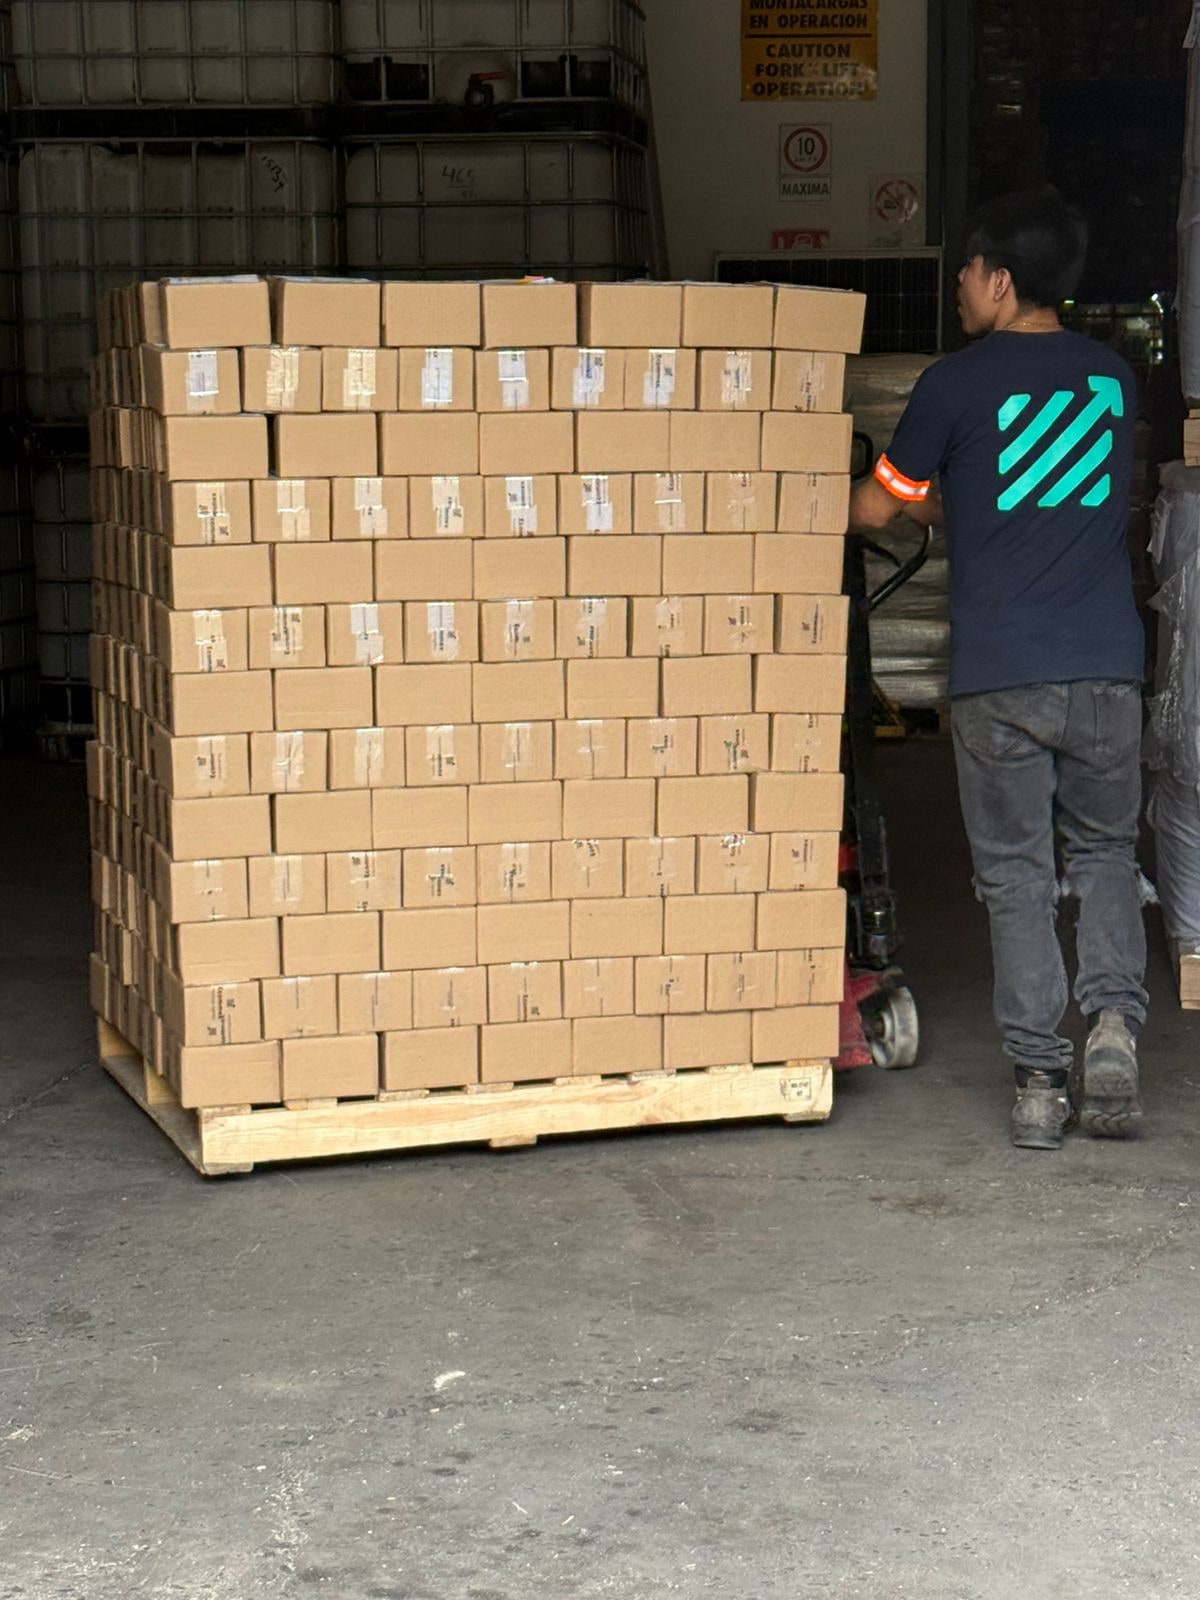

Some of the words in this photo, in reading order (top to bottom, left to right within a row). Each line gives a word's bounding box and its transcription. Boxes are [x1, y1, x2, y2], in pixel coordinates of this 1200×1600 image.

[749, 14, 769, 29] EN
[777, 13, 868, 28] OPERACION
[765, 43, 851, 58] CAUTION
[754, 63, 805, 77] FORK
[822, 63, 860, 77] LIFT
[751, 82, 865, 97] OPERATION
[797, 137, 816, 156] 10
[782, 183, 831, 196] MAXIMA
